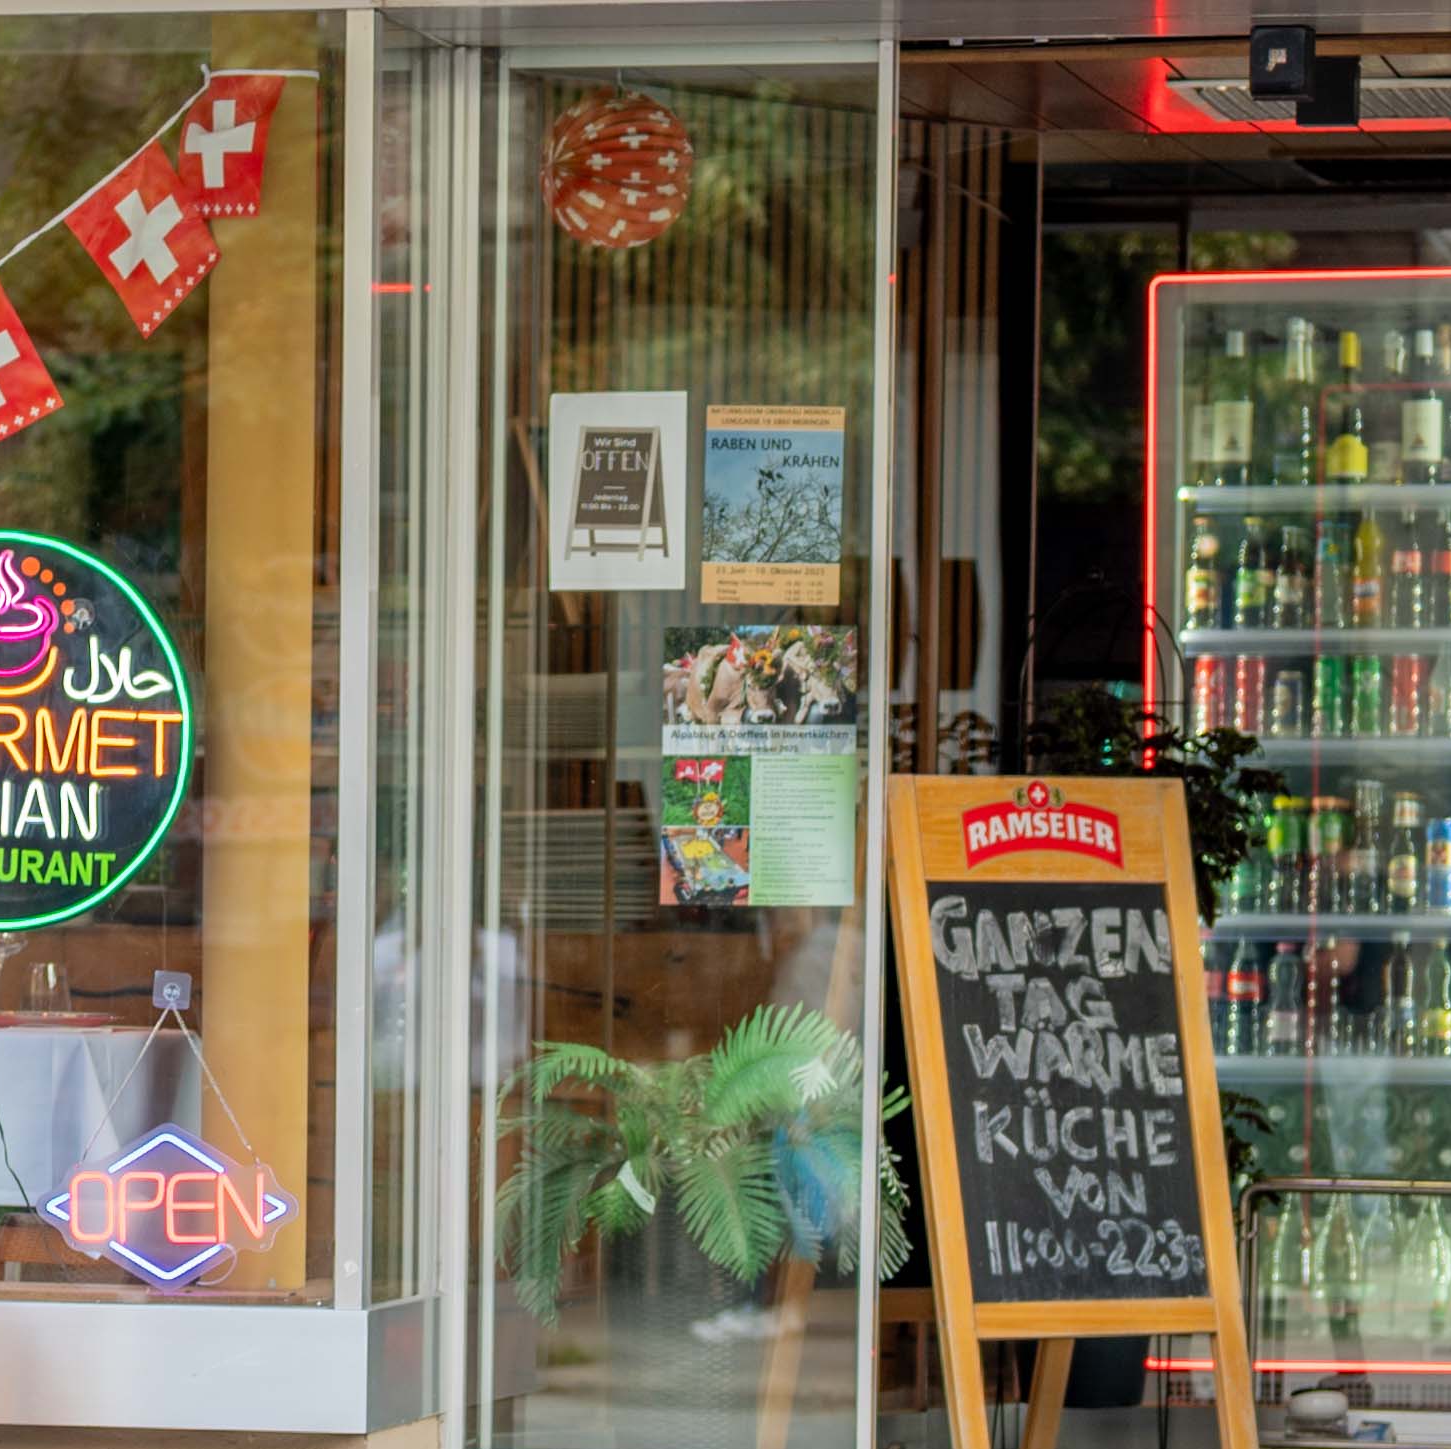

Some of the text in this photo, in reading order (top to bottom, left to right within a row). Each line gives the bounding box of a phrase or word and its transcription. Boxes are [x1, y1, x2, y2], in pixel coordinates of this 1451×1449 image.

[580, 449, 649, 471] OFFEN
[711, 438, 792, 451] RABEN UND
[782, 454, 840, 468] KRÄHEN
[63, 635, 173, 703] حلال
[967, 810, 1117, 854] RAMSEIER
[930, 895, 1173, 981] GANZEN
[985, 972, 1119, 1032] TAG
[973, 1087, 1178, 1166] KÜCHE
[69, 1171, 266, 1245] OPEN
[1034, 1165, 1148, 1220] VON
